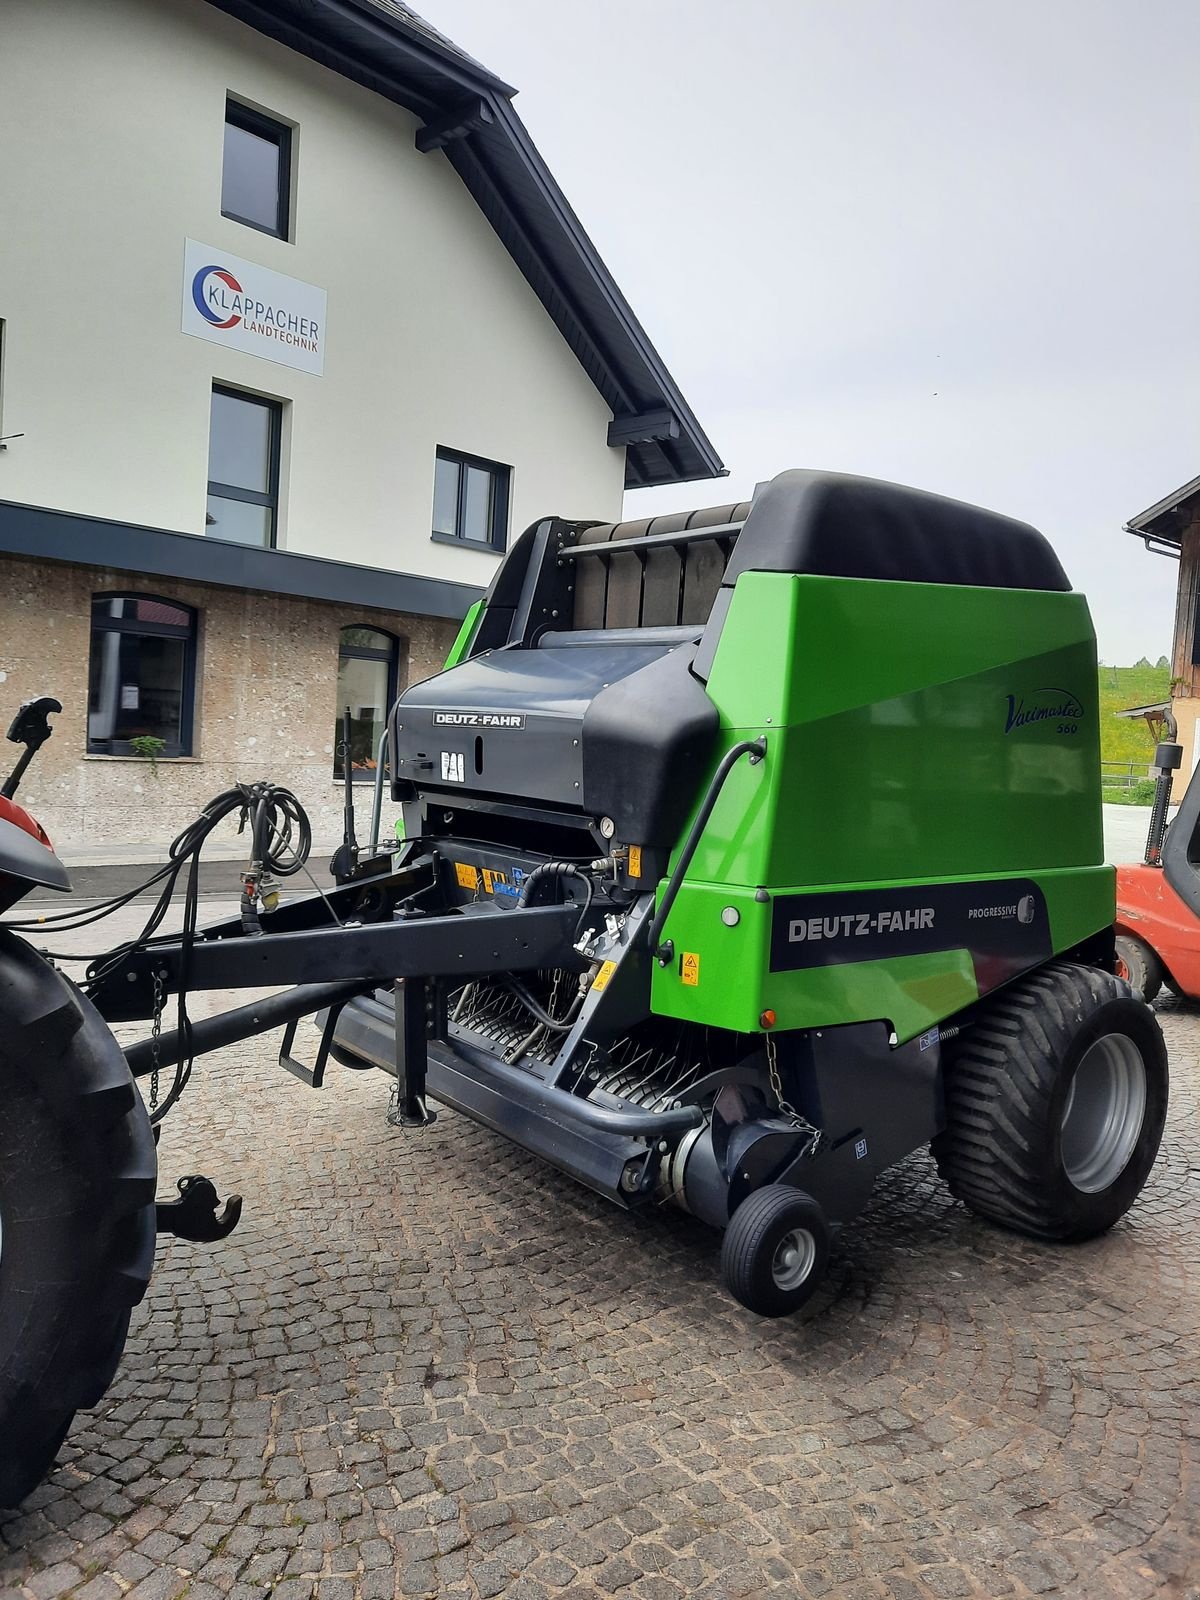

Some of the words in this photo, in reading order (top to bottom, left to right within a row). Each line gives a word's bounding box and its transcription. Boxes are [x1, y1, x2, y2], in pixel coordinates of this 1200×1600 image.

[209, 285, 319, 340] KLAPPACHER
[243, 318, 318, 353] LANDTECHNIK
[436, 713, 521, 727] DEUTZ-FAHR
[1056, 723, 1078, 734] 560
[968, 905, 1017, 919] PROGRESSIVE
[788, 908, 935, 943] DEUTZ-FAHR
